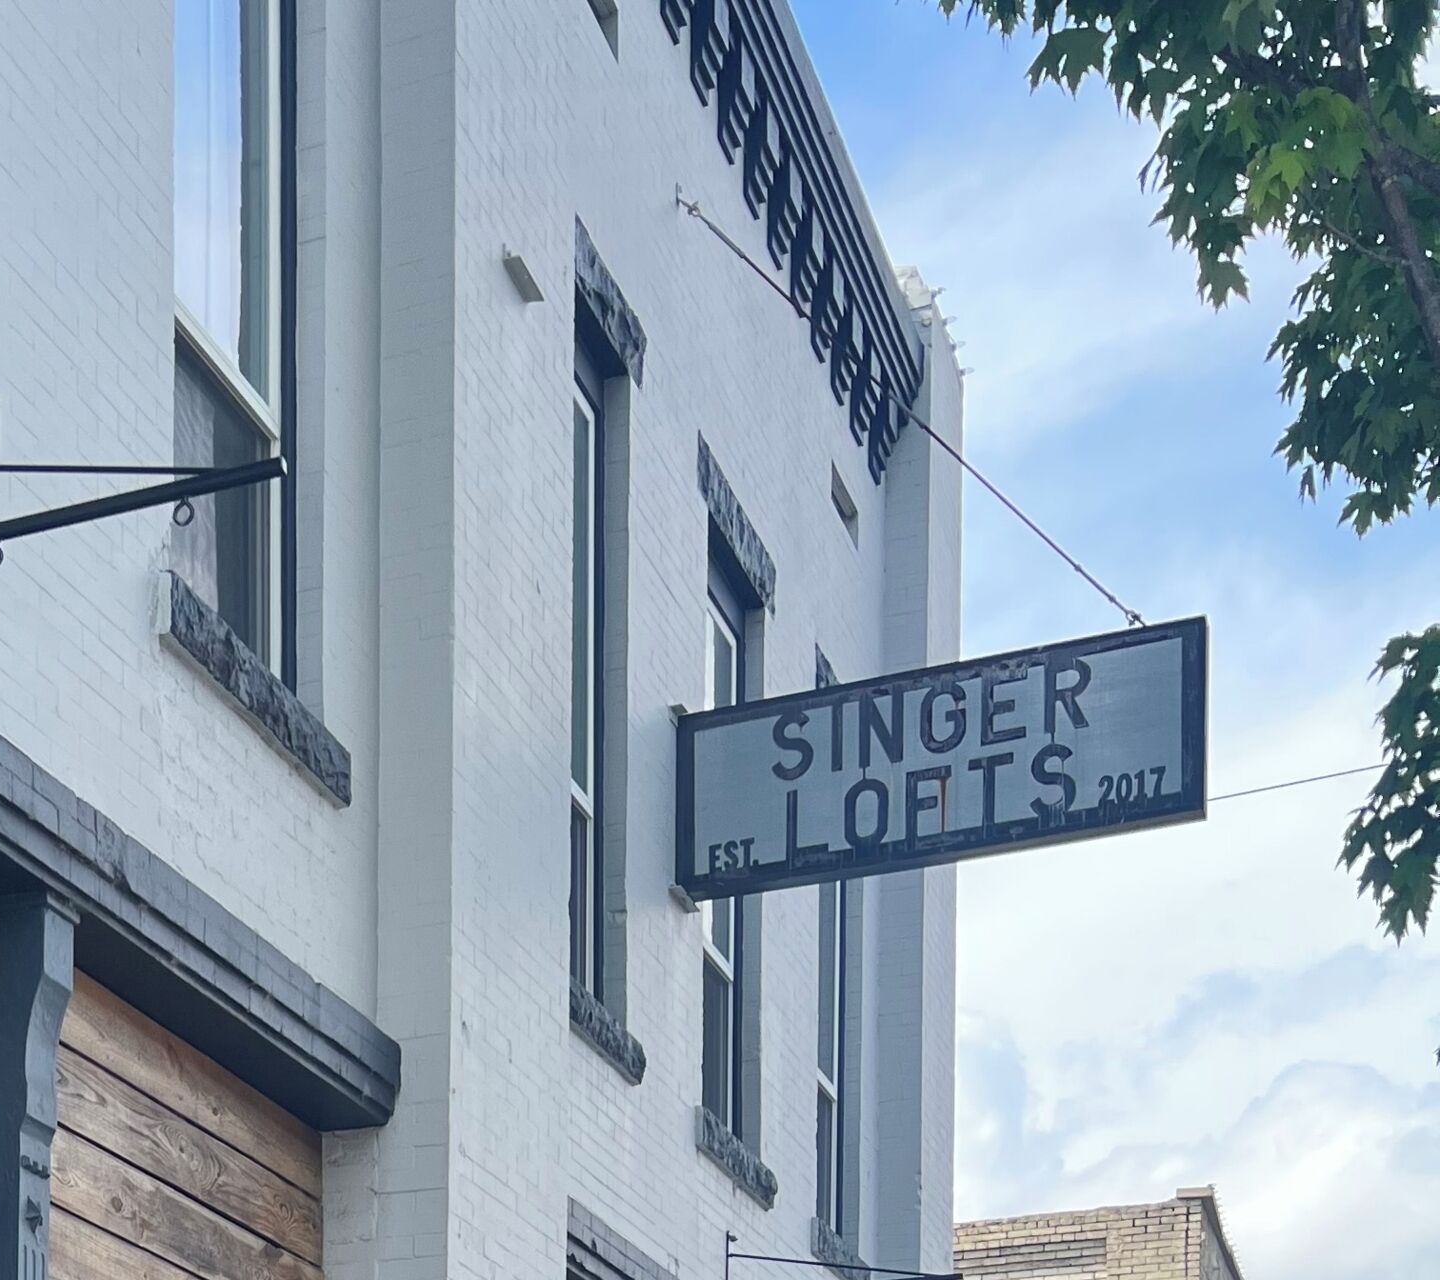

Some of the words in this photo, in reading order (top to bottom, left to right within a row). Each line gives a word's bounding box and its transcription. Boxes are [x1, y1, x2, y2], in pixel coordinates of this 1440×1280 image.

[772, 657, 1092, 781] SINGER
[708, 836, 760, 874] EST.
[1097, 765, 1167, 809] 2017
[786, 743, 1077, 868] LOFTS
